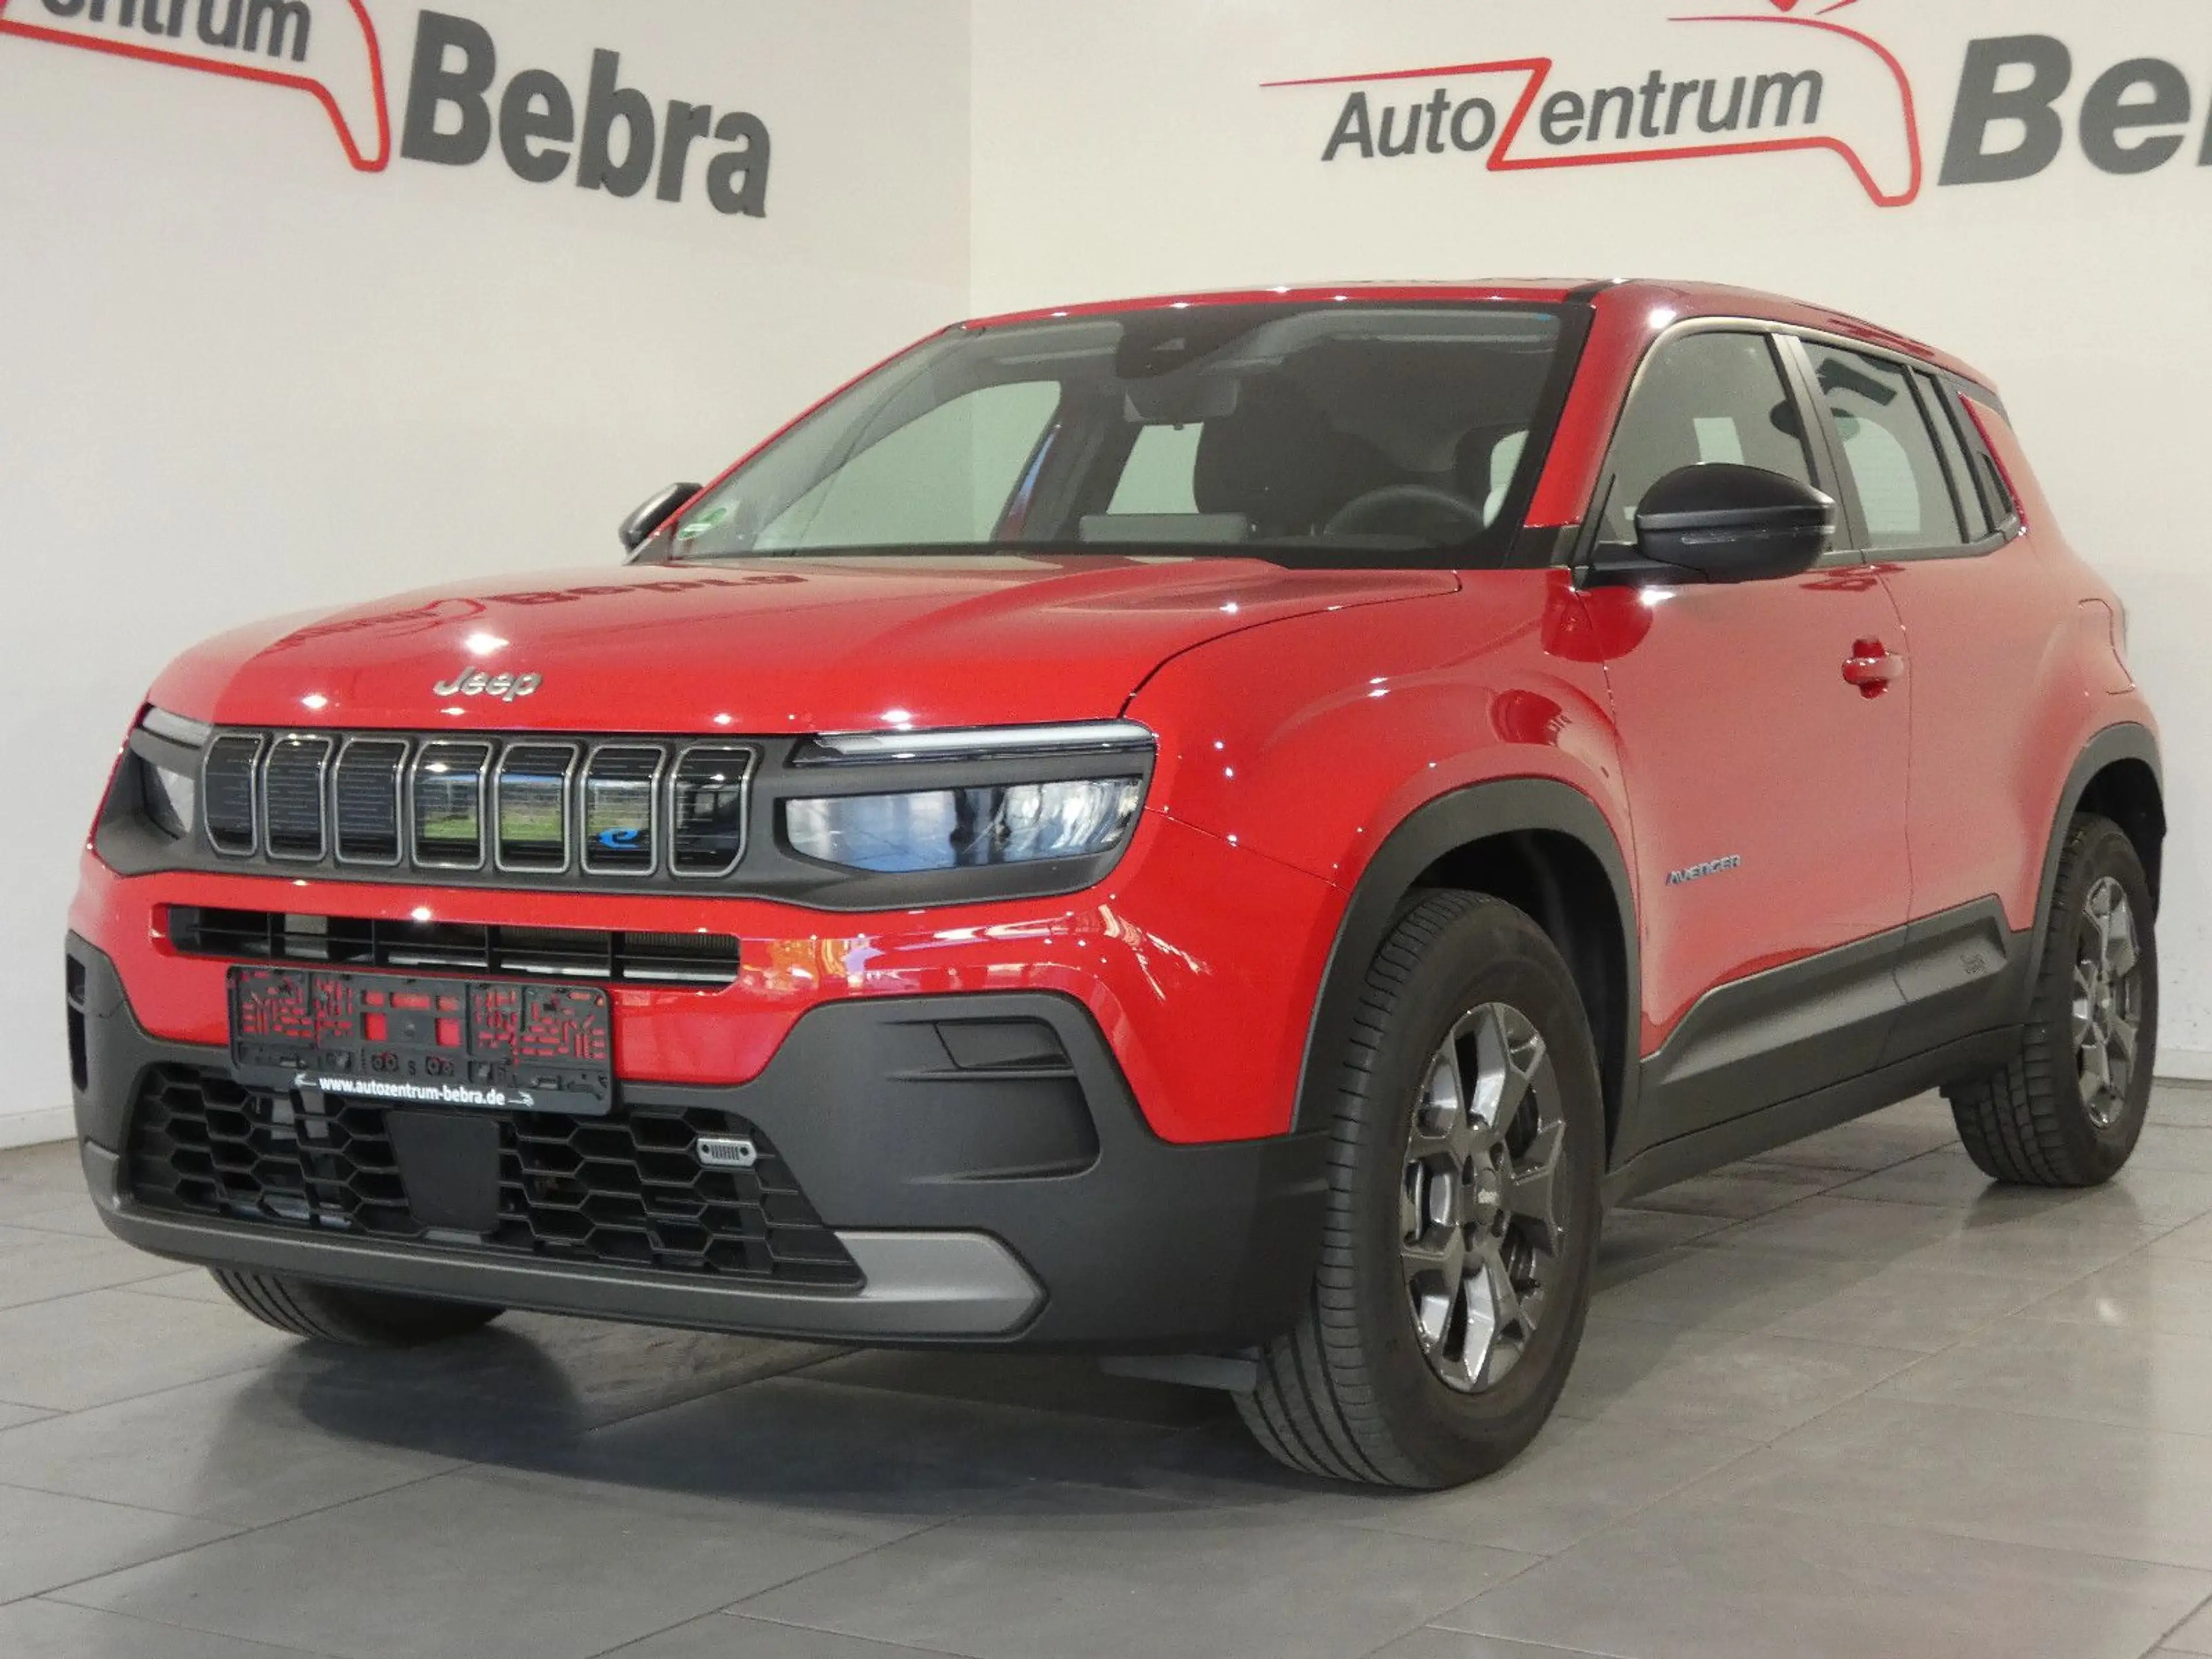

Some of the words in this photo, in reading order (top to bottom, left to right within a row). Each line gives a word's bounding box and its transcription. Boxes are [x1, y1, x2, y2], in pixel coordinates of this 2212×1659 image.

[400, 10, 770, 218] Bebra
[1321, 57, 1823, 172] AutoZentrum
[1937, 35, 2212, 185] Be
[433, 666, 542, 702] Jeep
[319, 1071, 505, 1106] www.autozentrum-bebra.de
